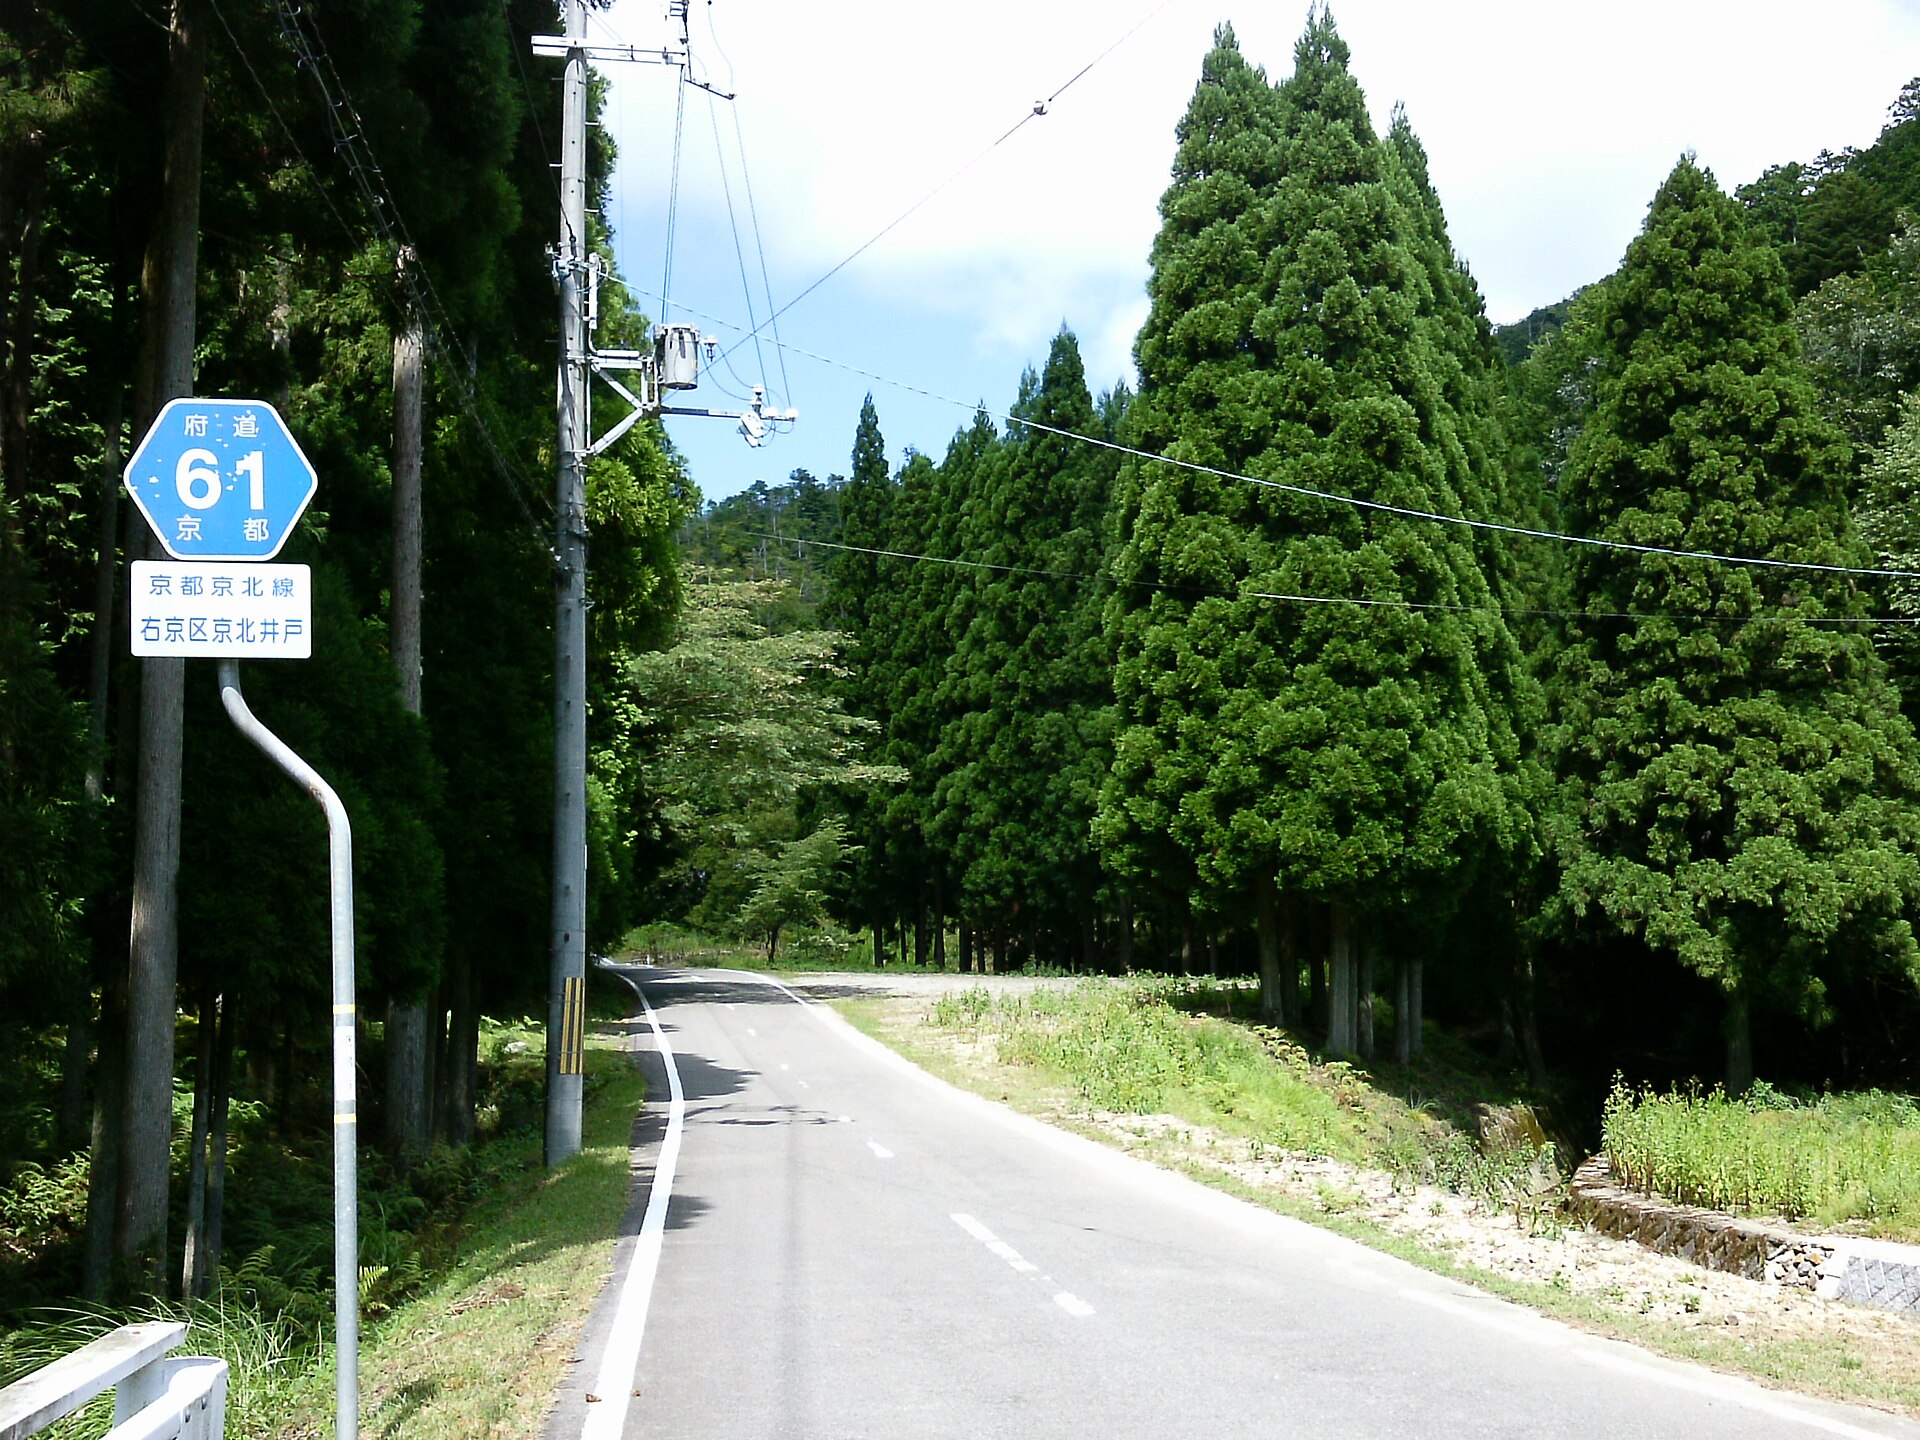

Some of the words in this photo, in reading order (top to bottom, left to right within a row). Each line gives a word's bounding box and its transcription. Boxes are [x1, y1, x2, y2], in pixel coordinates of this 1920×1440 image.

[184, 414, 259, 438] 府道
[175, 448, 264, 510] 61
[176, 514, 270, 542] 京都
[149, 575, 294, 597] 京都京北線
[141, 617, 303, 643] 右京区京北井戸
